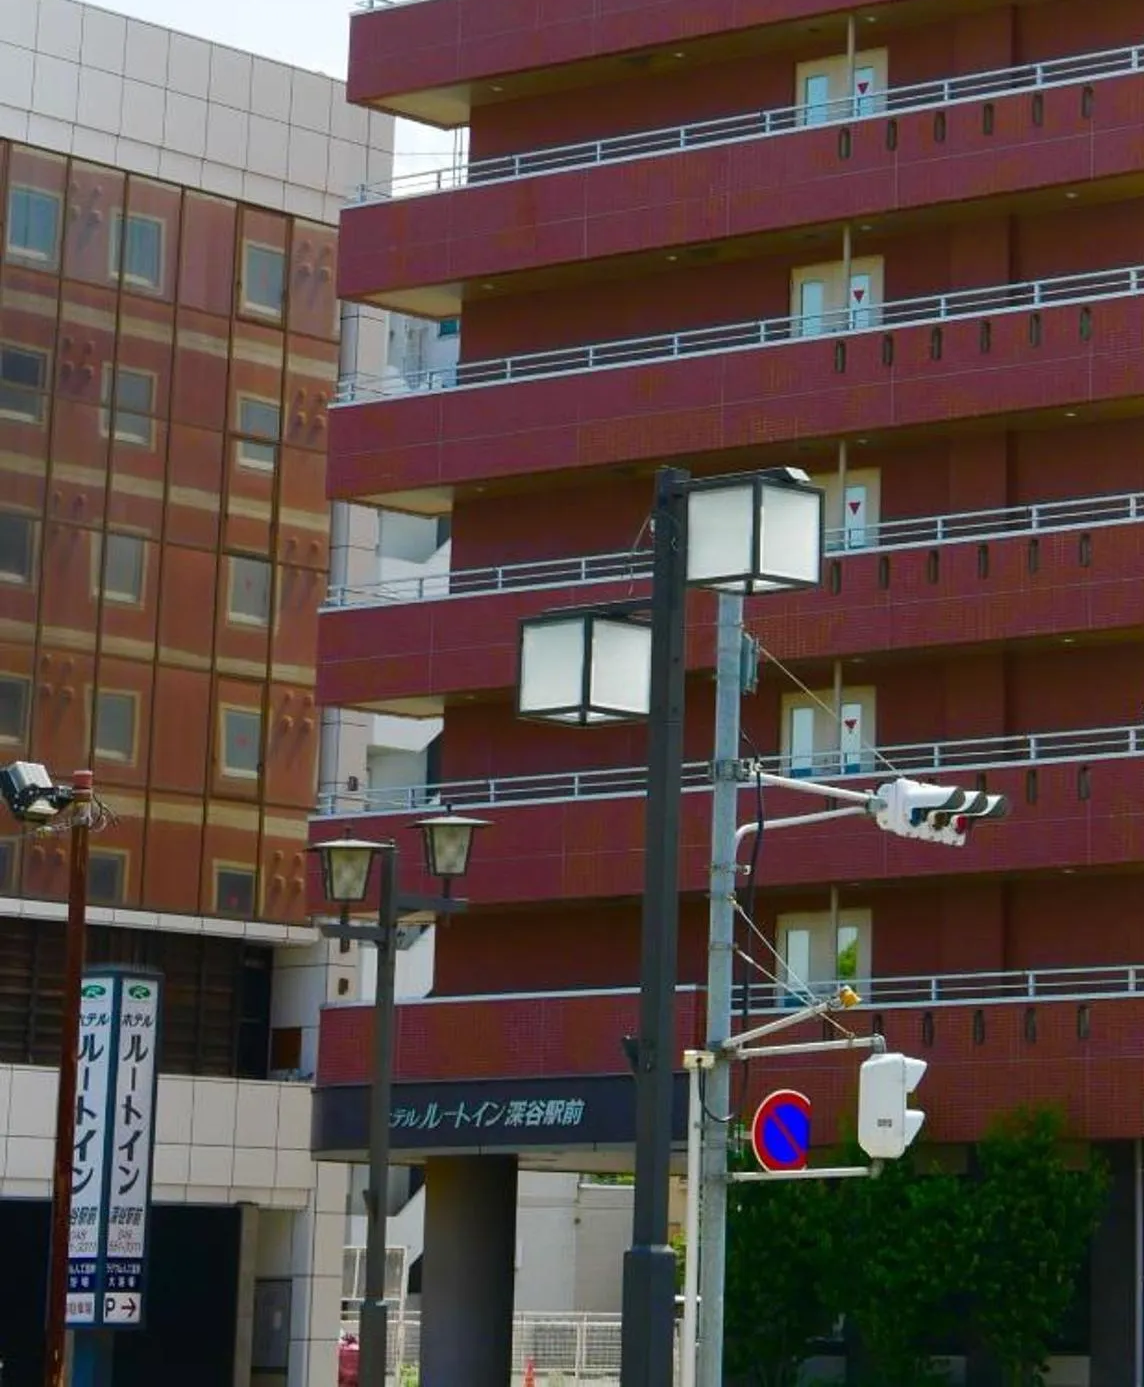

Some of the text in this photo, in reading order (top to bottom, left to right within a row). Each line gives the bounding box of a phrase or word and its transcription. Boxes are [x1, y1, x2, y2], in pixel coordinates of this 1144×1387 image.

[121, 1014, 153, 1028] ホテル
[72, 1033, 104, 1194] ルートイン
[118, 1034, 149, 1195] ルートイン
[104, 1297, 116, 1318] P
